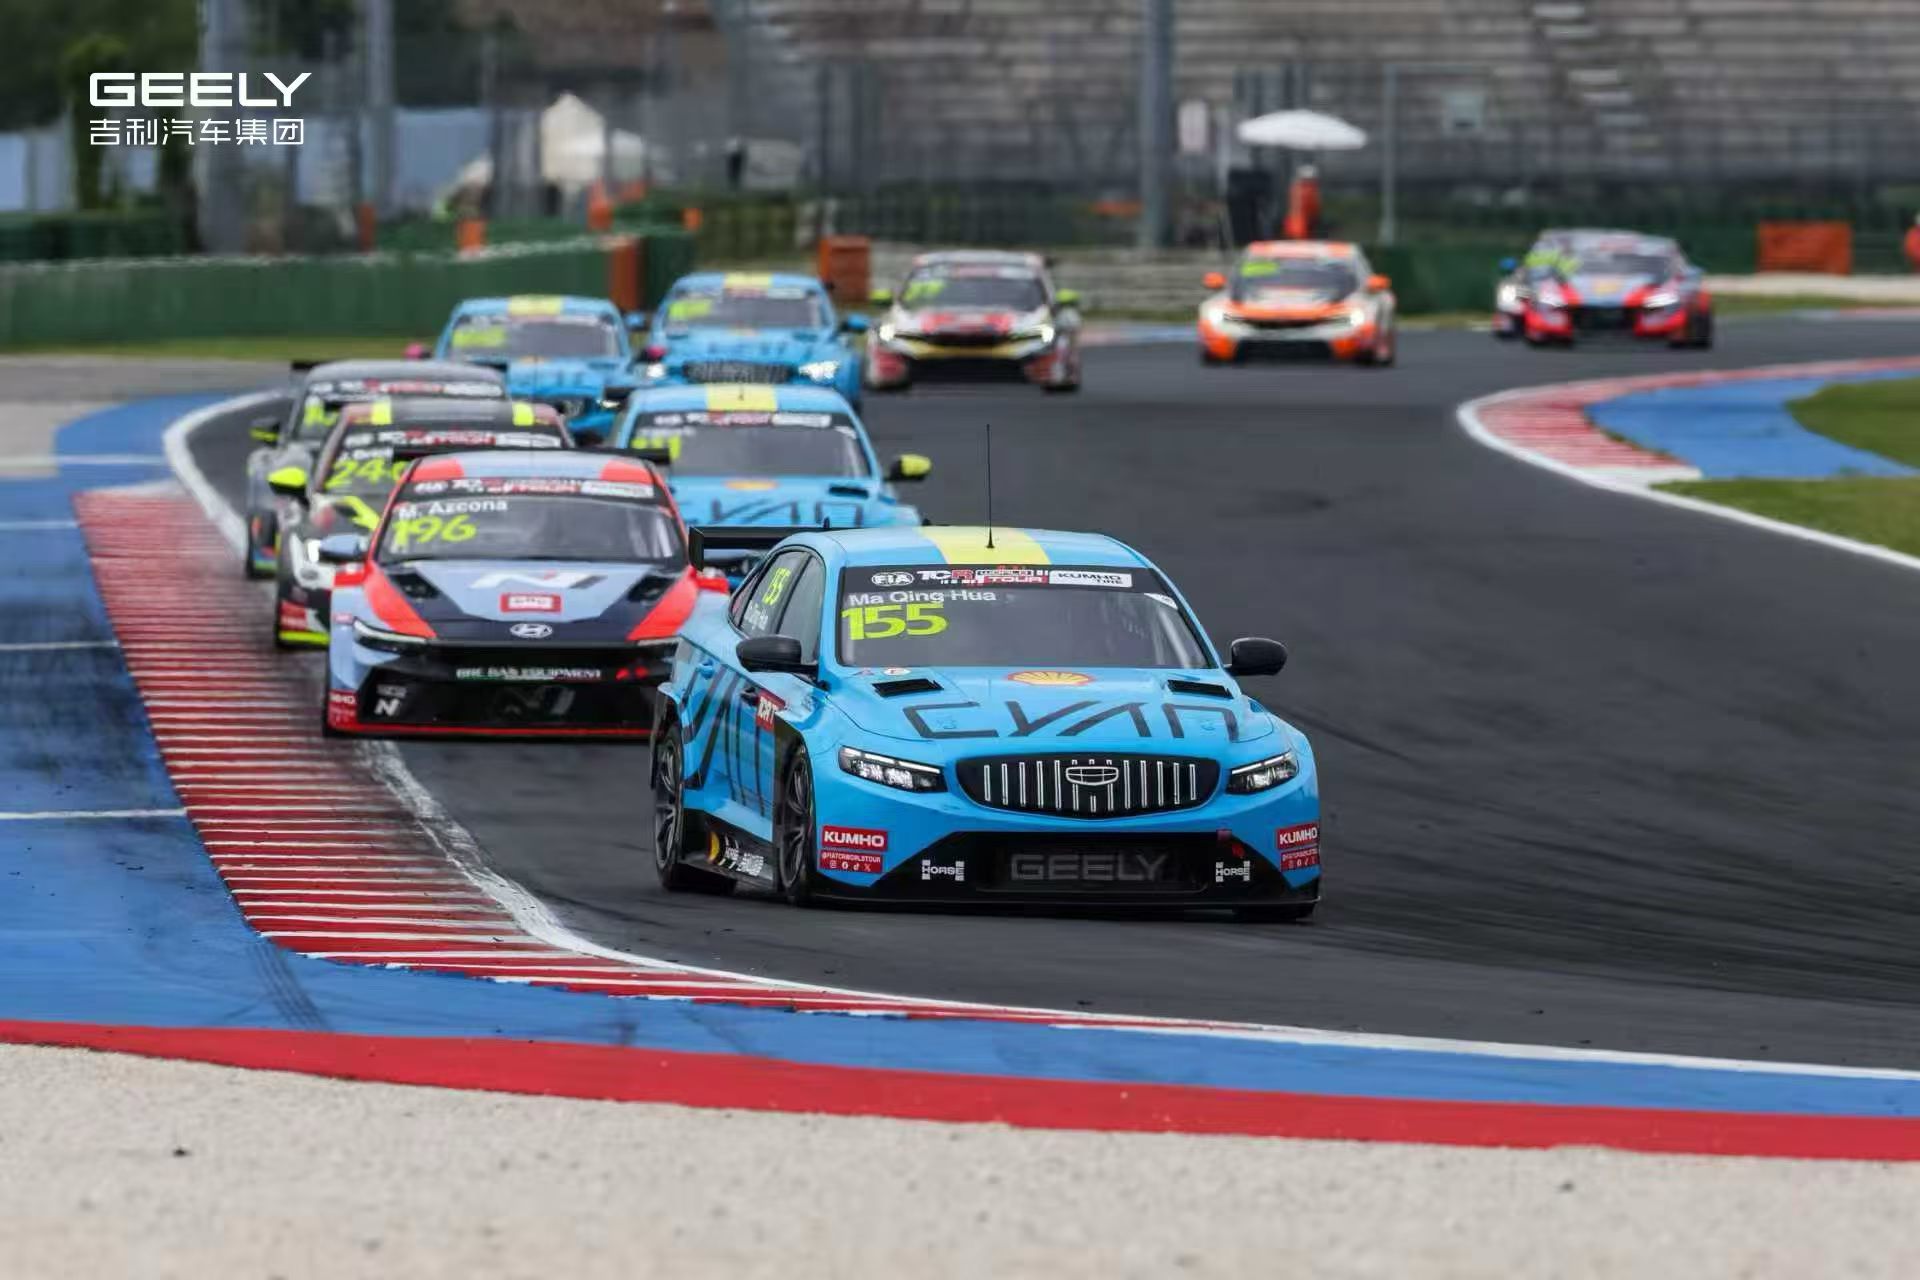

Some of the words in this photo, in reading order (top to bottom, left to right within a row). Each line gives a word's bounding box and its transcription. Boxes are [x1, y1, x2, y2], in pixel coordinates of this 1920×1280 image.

[428, 500, 509, 515] Azcona
[393, 513, 477, 547] 196
[873, 572, 913, 586] FIA
[989, 575, 1043, 584] TOUR
[1057, 573, 1121, 581] KUMHO
[848, 594, 884, 606] Ma
[889, 590, 945, 603] Qing
[951, 589, 997, 601] Hua
[841, 602, 948, 641] 155
[824, 831, 885, 847] KUMHO
[1279, 827, 1318, 845] KUMHO
[921, 859, 965, 882] HORSE
[1011, 853, 1169, 881] GEELY
[1215, 860, 1251, 883] HORSE
